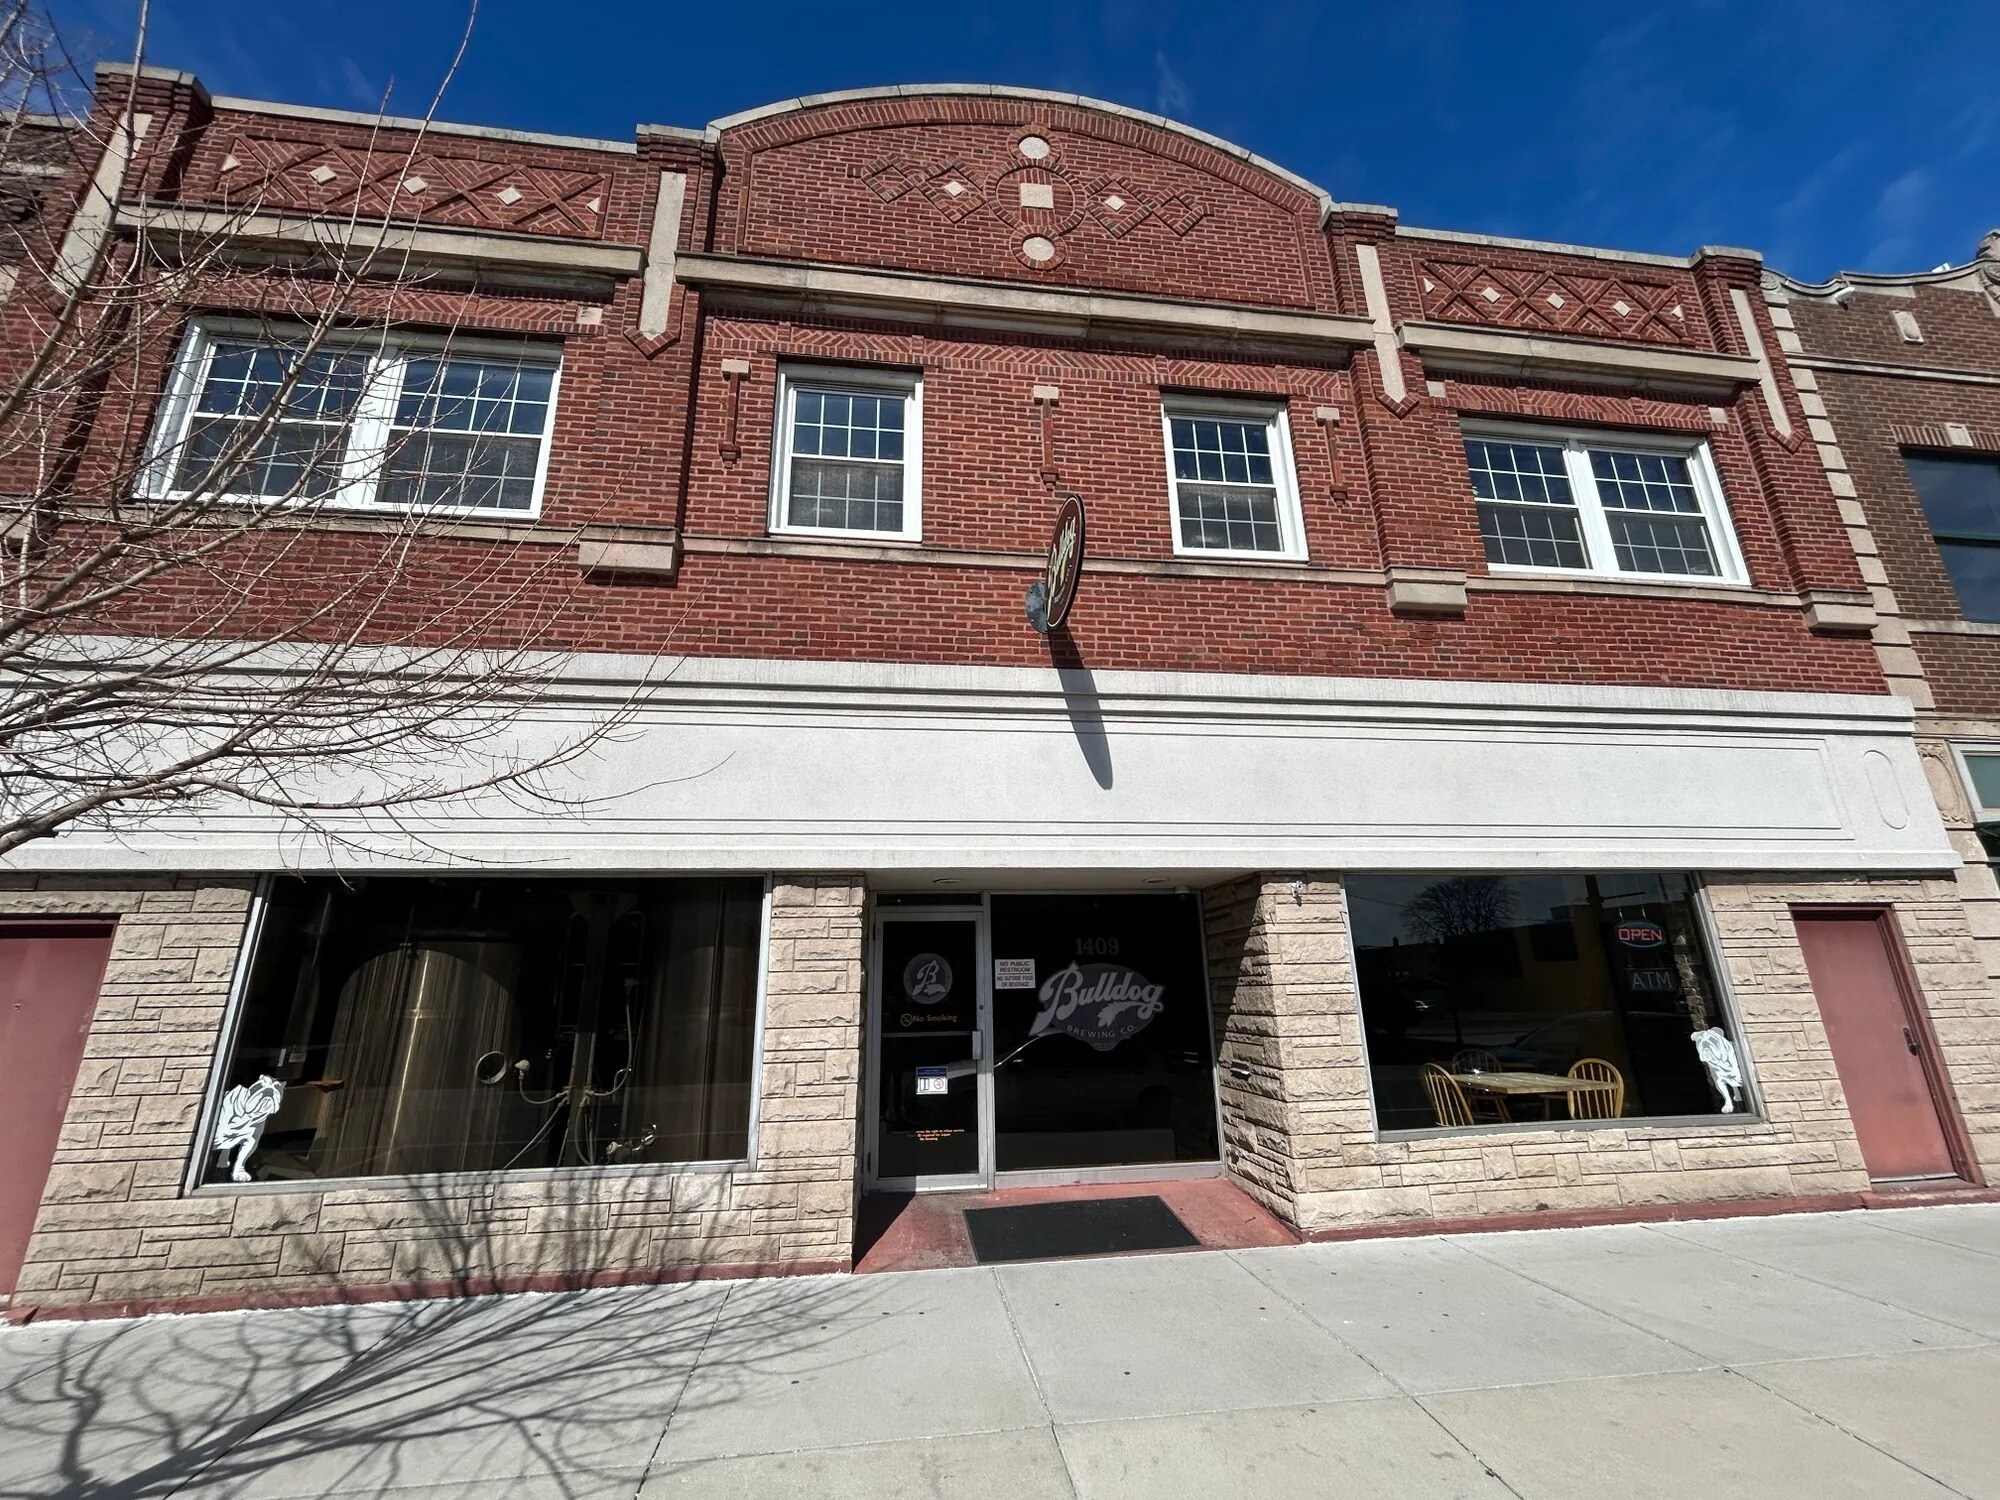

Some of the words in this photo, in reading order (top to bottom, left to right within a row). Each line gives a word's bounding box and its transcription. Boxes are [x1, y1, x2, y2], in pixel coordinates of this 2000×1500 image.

[1618, 928, 1663, 941] OPEN
[1075, 937, 1120, 955] 1409
[1632, 972, 1673, 989] ATM
[1029, 960, 1165, 1037] Bulldog
[912, 1014, 925, 1022] No
[926, 1013, 958, 1023] Smoking
[1066, 1025, 1115, 1038] BREWING
